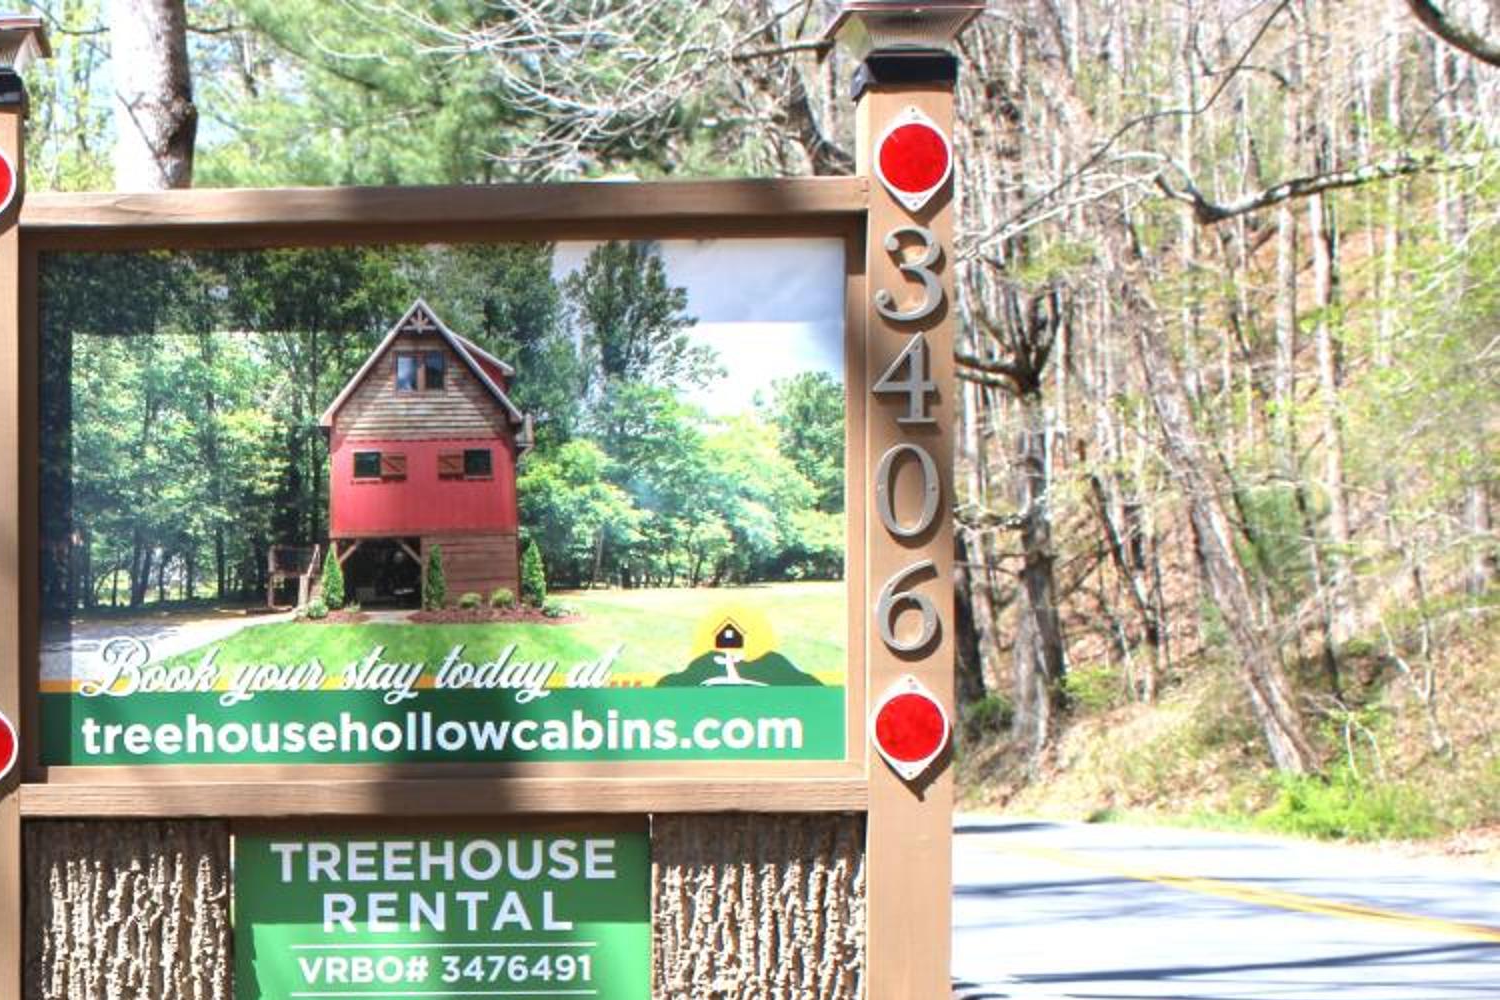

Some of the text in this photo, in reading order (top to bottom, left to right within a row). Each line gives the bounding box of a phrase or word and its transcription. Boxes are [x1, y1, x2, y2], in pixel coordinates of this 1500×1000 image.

[874, 226, 944, 652] 3406
[79, 635, 221, 696] Book
[219, 659, 325, 706] your
[341, 645, 429, 705] stay
[433, 643, 559, 703] today
[81, 709, 804, 755] treehousehollowcabins.com
[270, 838, 616, 882] TREEHOUSE
[323, 891, 573, 933] RENTAL
[298, 954, 591, 984] VRBO# 3476491
